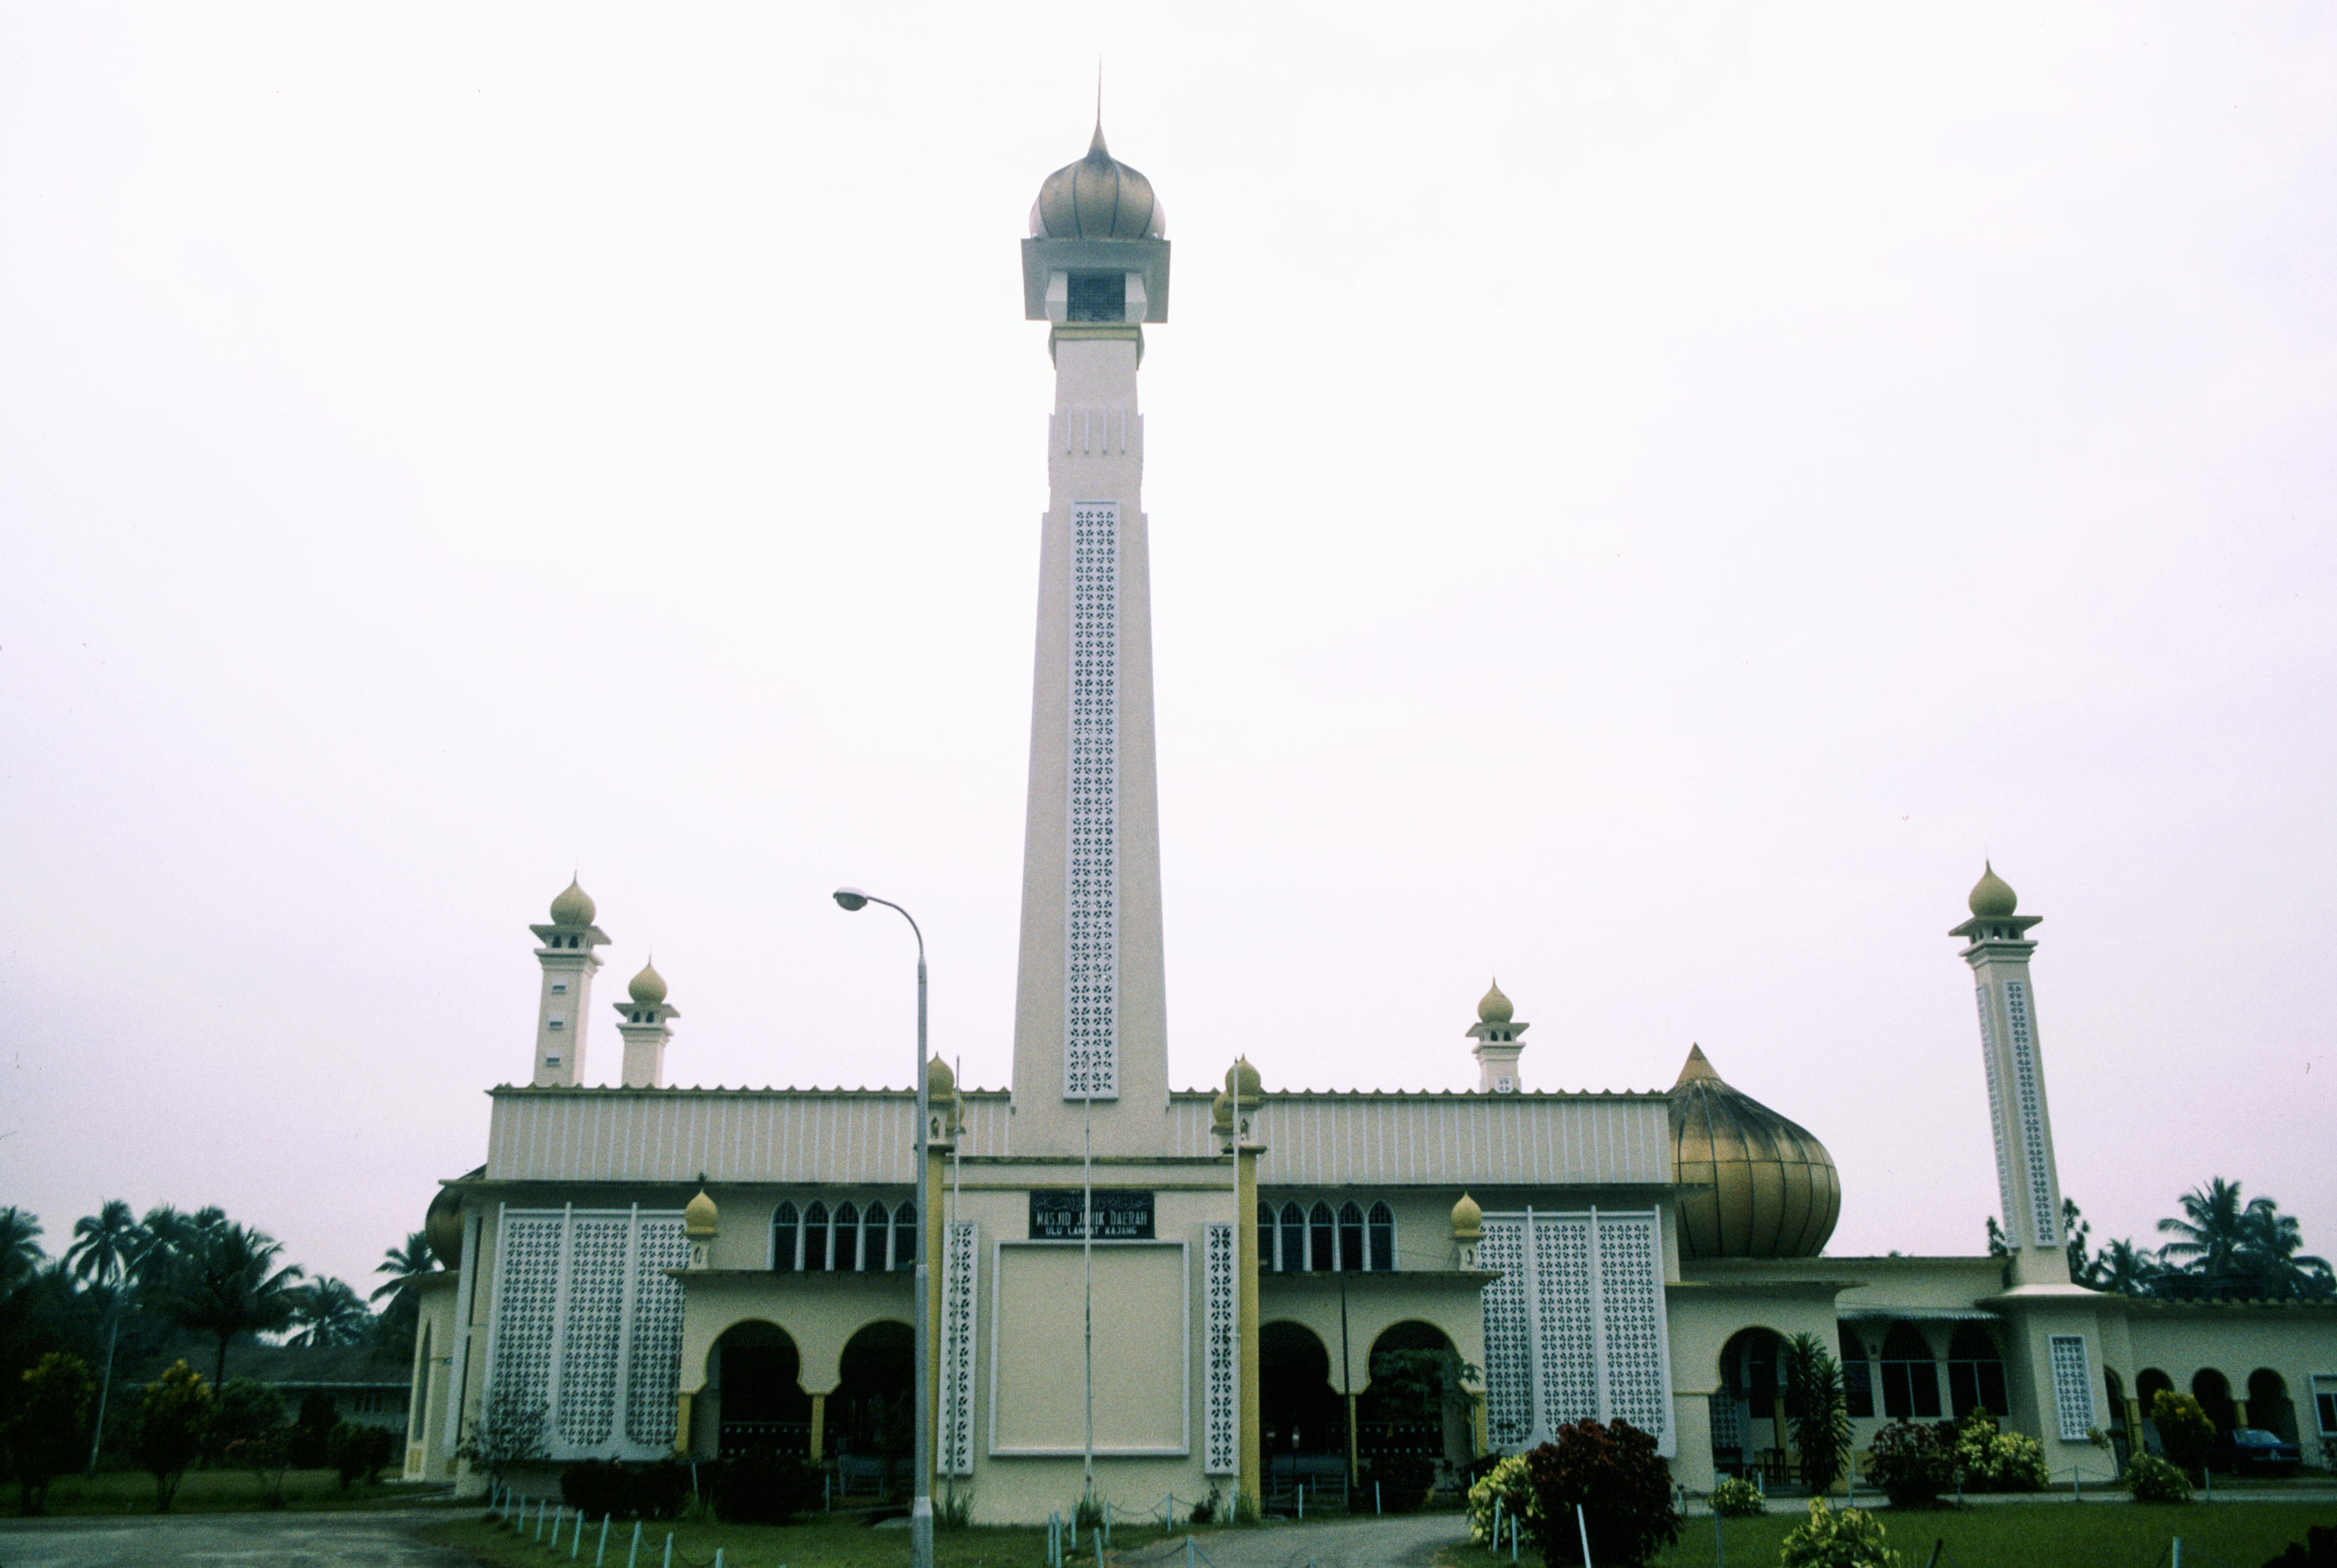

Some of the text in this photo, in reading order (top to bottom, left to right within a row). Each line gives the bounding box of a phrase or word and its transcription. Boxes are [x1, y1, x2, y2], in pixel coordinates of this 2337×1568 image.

[1037, 1211, 1071, 1226] MASJID
[1110, 1210, 1147, 1225] DAERAH
[1045, 1226, 1137, 1235] ULU LANAT KAJANG
